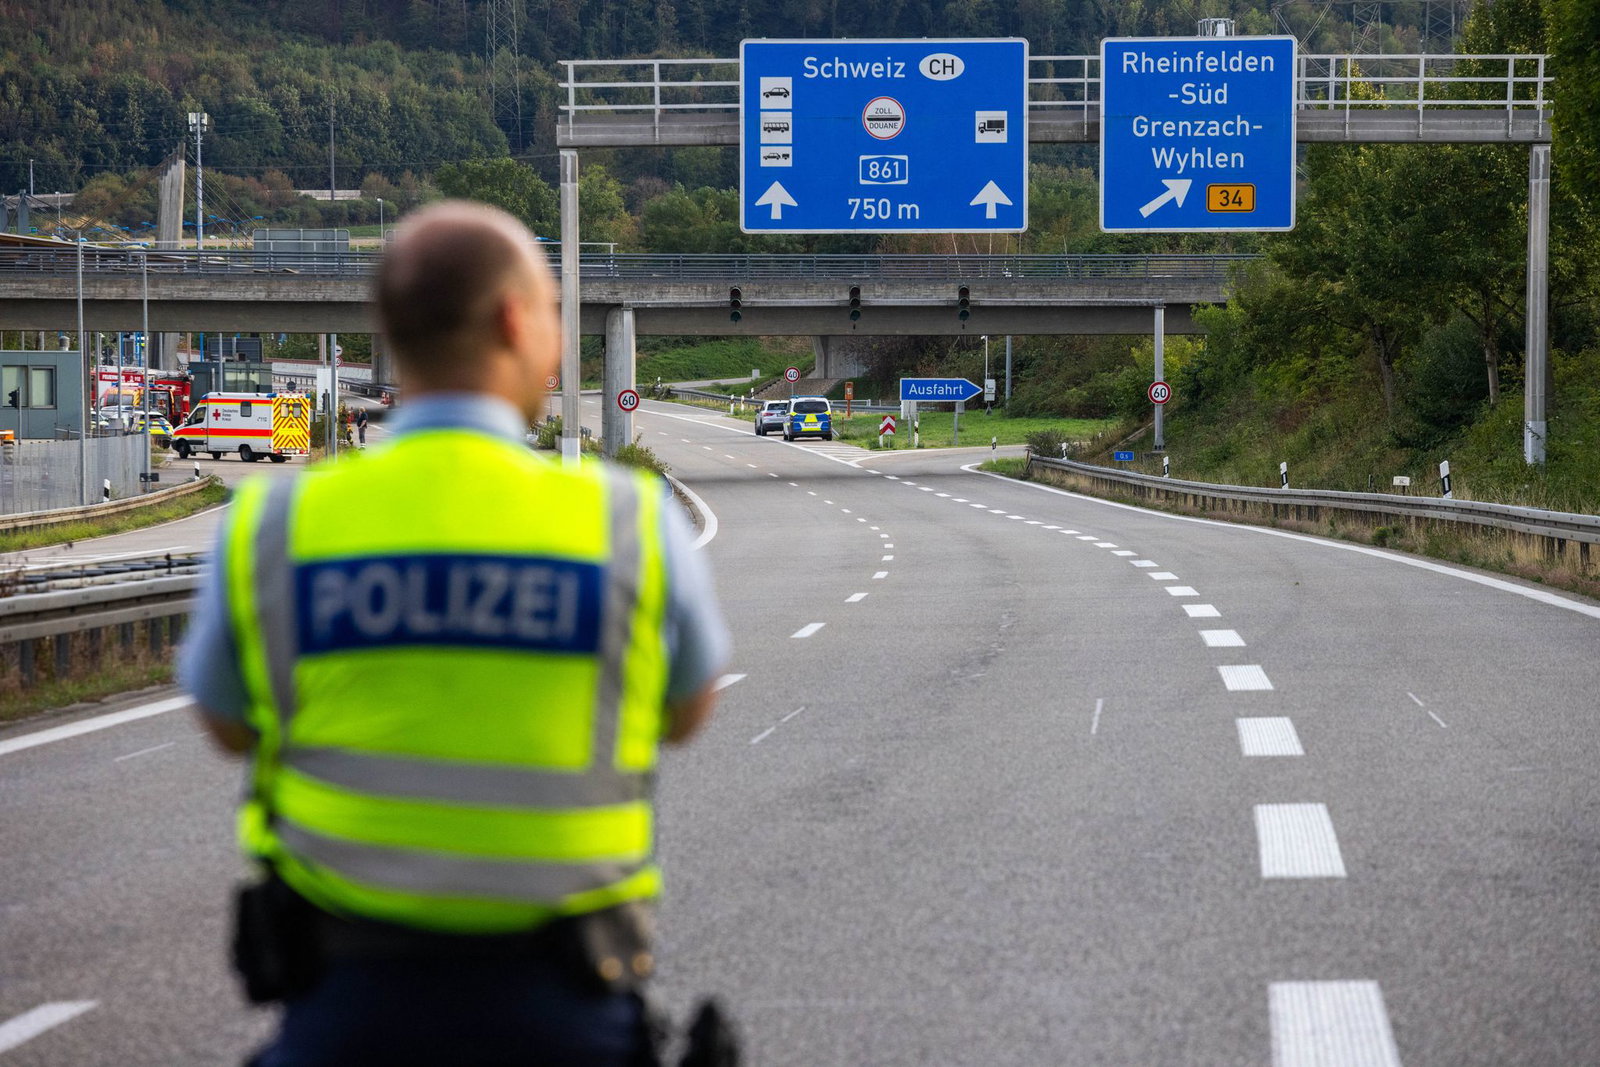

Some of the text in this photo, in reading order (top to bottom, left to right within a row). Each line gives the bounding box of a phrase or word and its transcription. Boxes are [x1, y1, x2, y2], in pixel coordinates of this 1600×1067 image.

[803, 56, 955, 79] Schweiz CH
[1122, 51, 1274, 74] Rheinfelden
[1168, 83, 1228, 105] -Süd
[874, 107, 893, 115] ZOLL
[1132, 115, 1263, 137] Grenzach-
[869, 161, 899, 179] 861
[1151, 147, 1244, 174] Wyhlen
[1219, 189, 1243, 207] 34
[848, 198, 920, 220] 750 m
[788, 370, 798, 379] 40
[908, 383, 963, 395] Ausfahrt
[1154, 387, 1166, 398] 60
[622, 395, 635, 406] 60
[311, 562, 580, 642] POLIZEI
